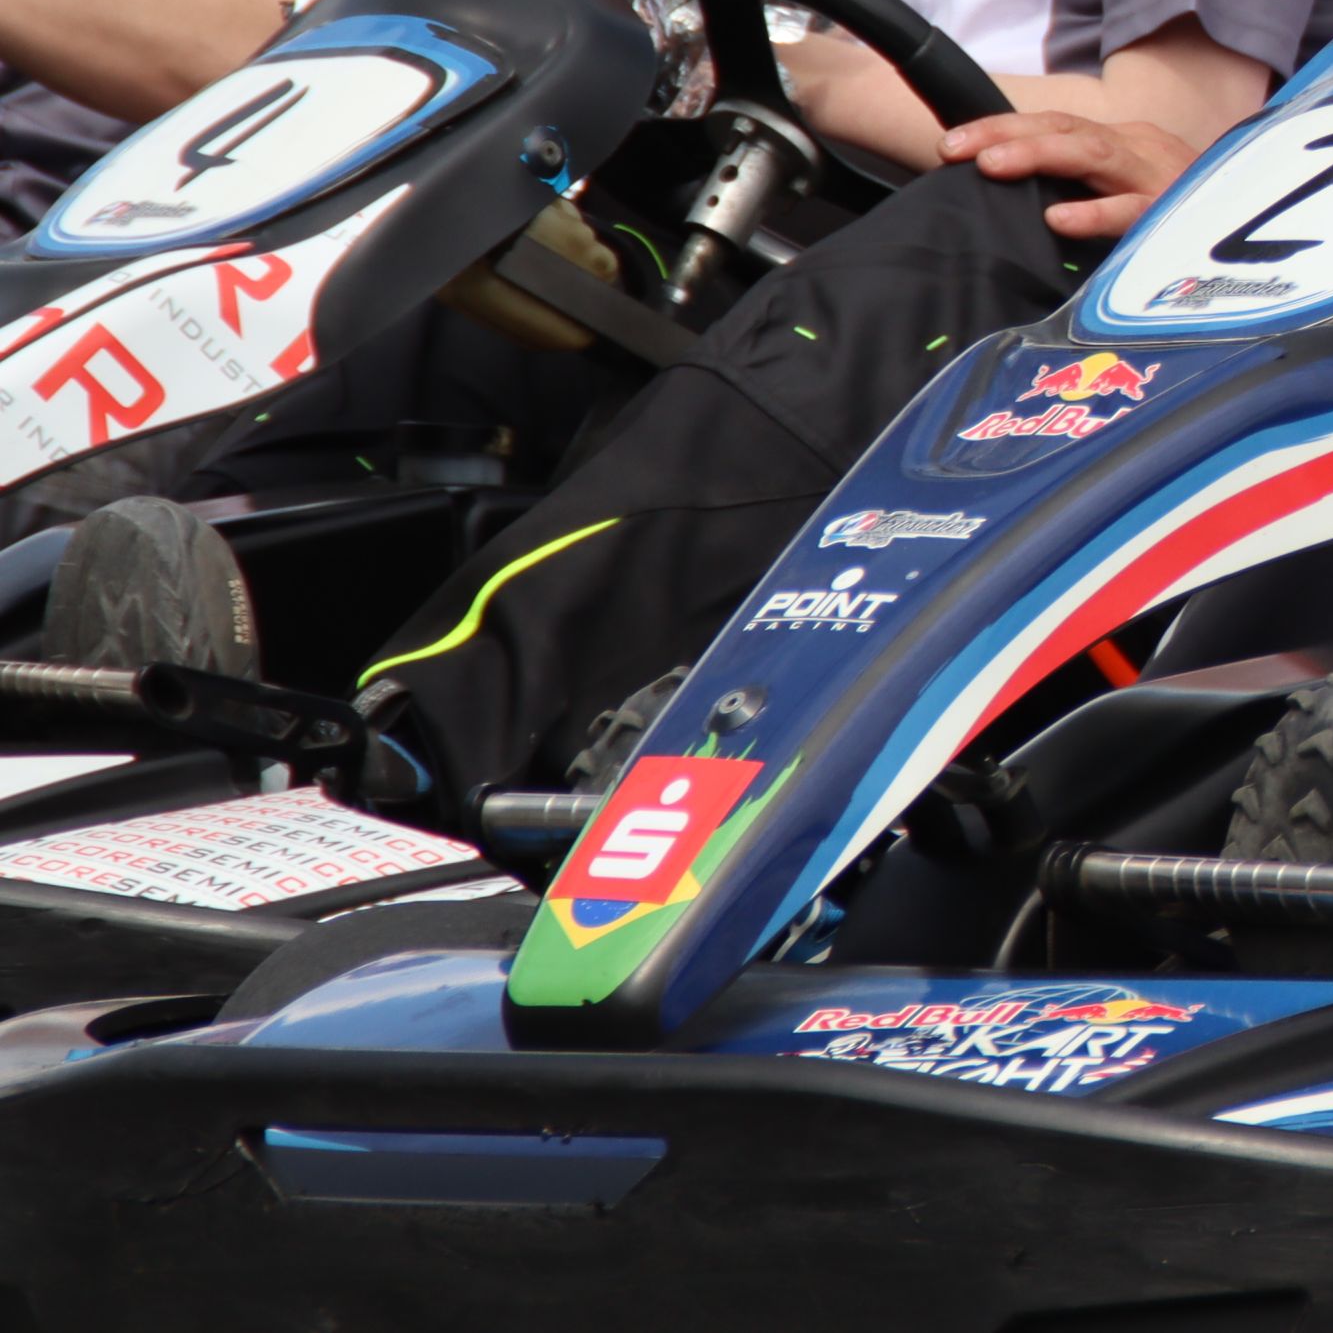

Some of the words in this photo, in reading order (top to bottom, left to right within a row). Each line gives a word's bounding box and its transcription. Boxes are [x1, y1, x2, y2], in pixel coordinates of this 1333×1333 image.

[174, 77, 309, 192] 4
[957, 404, 1065, 440] Red
[755, 592, 898, 619] POINT
[743, 620, 876, 633] RACING
[793, 1006, 910, 1034] Red
[904, 1002, 1029, 1028] Bull
[950, 1024, 1174, 1059] KART
